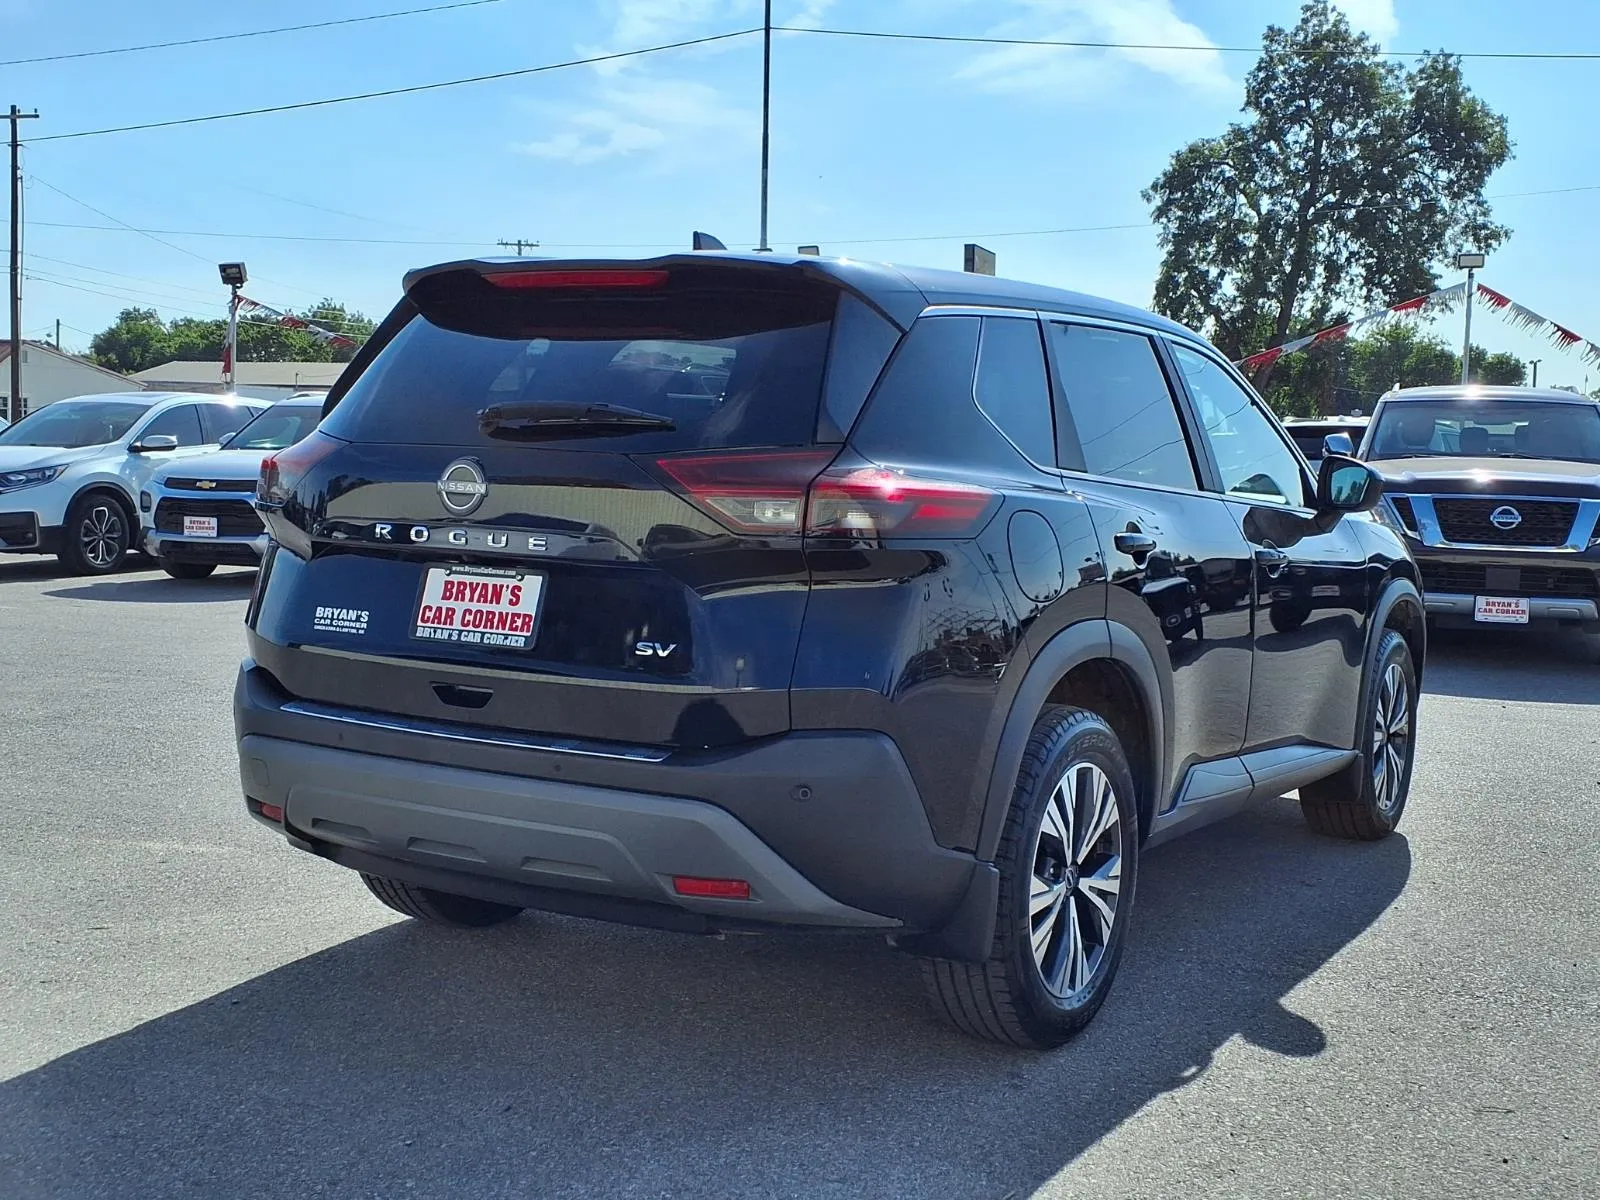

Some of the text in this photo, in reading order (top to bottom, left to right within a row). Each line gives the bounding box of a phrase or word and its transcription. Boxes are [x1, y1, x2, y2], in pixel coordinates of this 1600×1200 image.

[437, 480, 486, 493] NISSAN
[375, 523, 548, 551] ROGUE
[441, 580, 523, 607] BRYAN'S
[1485, 600, 1520, 608] BRYAN'S
[315, 606, 370, 622] BRYAN'S
[420, 605, 534, 633] CAR CORNER
[332, 619, 368, 629] CORNER
[416, 626, 526, 647] BRYAN'S CAR CORNER
[635, 641, 677, 657] SV
